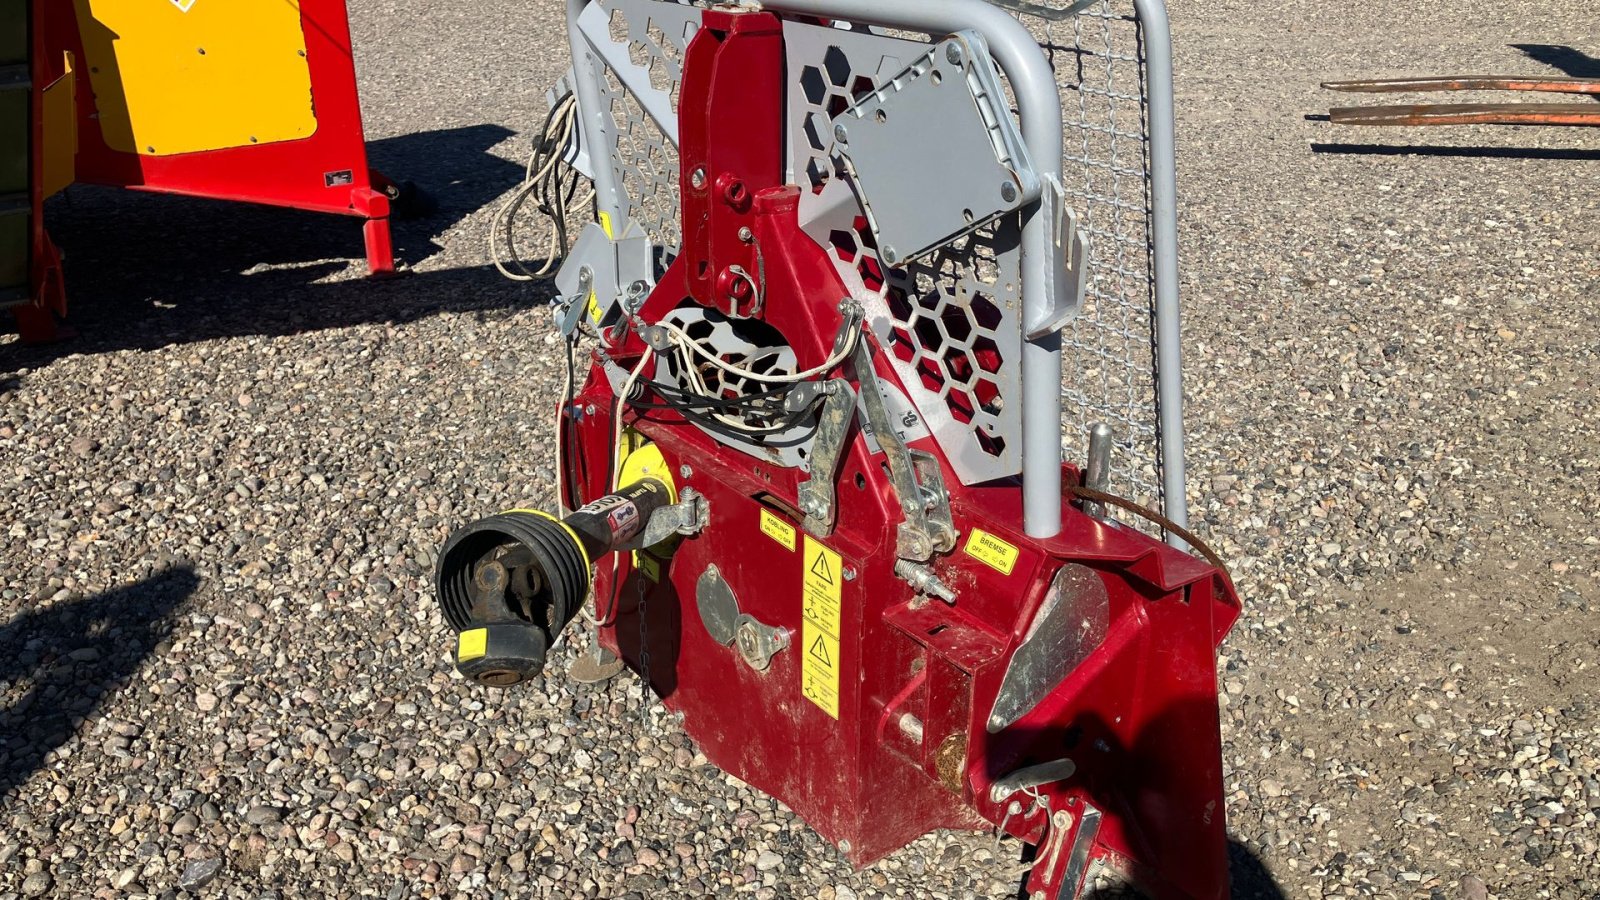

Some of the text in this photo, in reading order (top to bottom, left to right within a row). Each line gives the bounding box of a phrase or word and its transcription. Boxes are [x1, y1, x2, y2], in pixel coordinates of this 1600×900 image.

[767, 517, 789, 535] KOBLING
[980, 536, 1007, 556] BREMSE
[971, 545, 1007, 568] OFF ON
